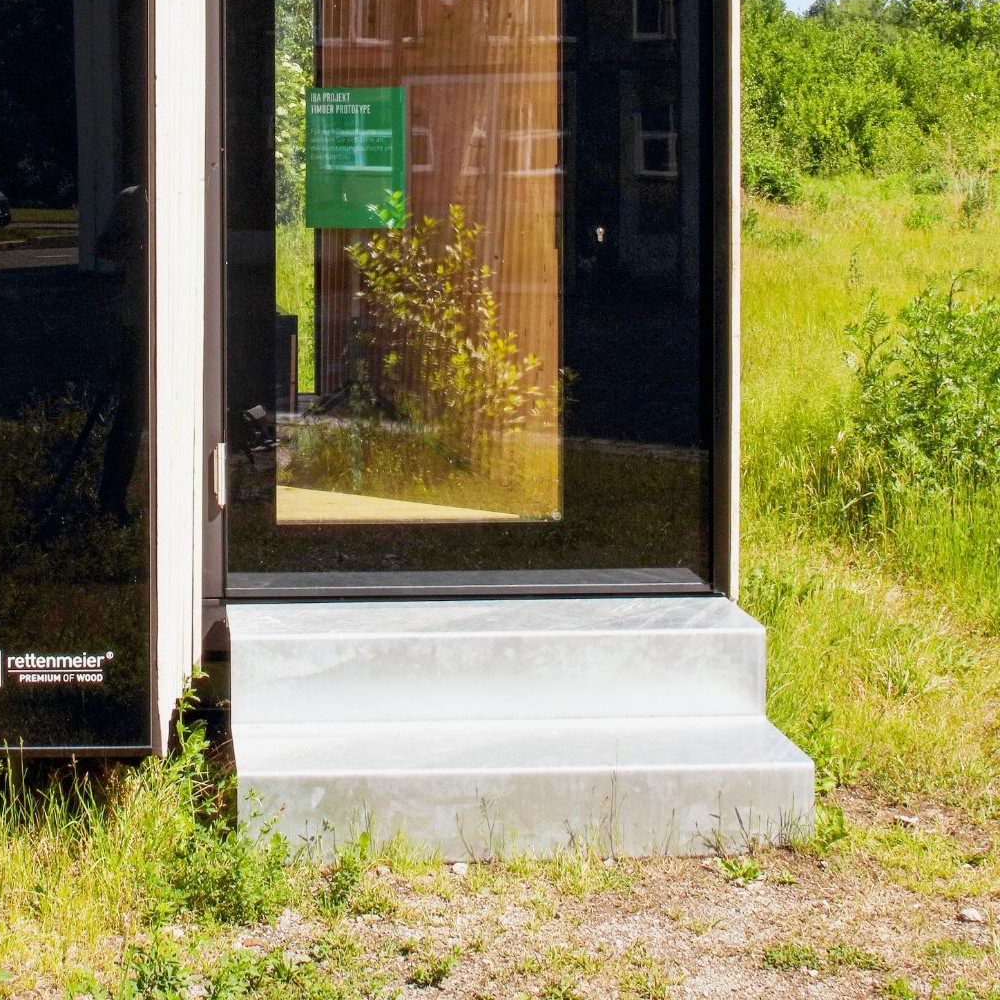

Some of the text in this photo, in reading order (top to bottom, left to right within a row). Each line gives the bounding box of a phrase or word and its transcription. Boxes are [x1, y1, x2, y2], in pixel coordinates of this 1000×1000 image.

[322, 92, 350, 102] PROJEKT
[311, 104, 371, 114] TIMBER PROTOTYPE
[19, 673, 103, 683] PREMIUM OF WOOD
